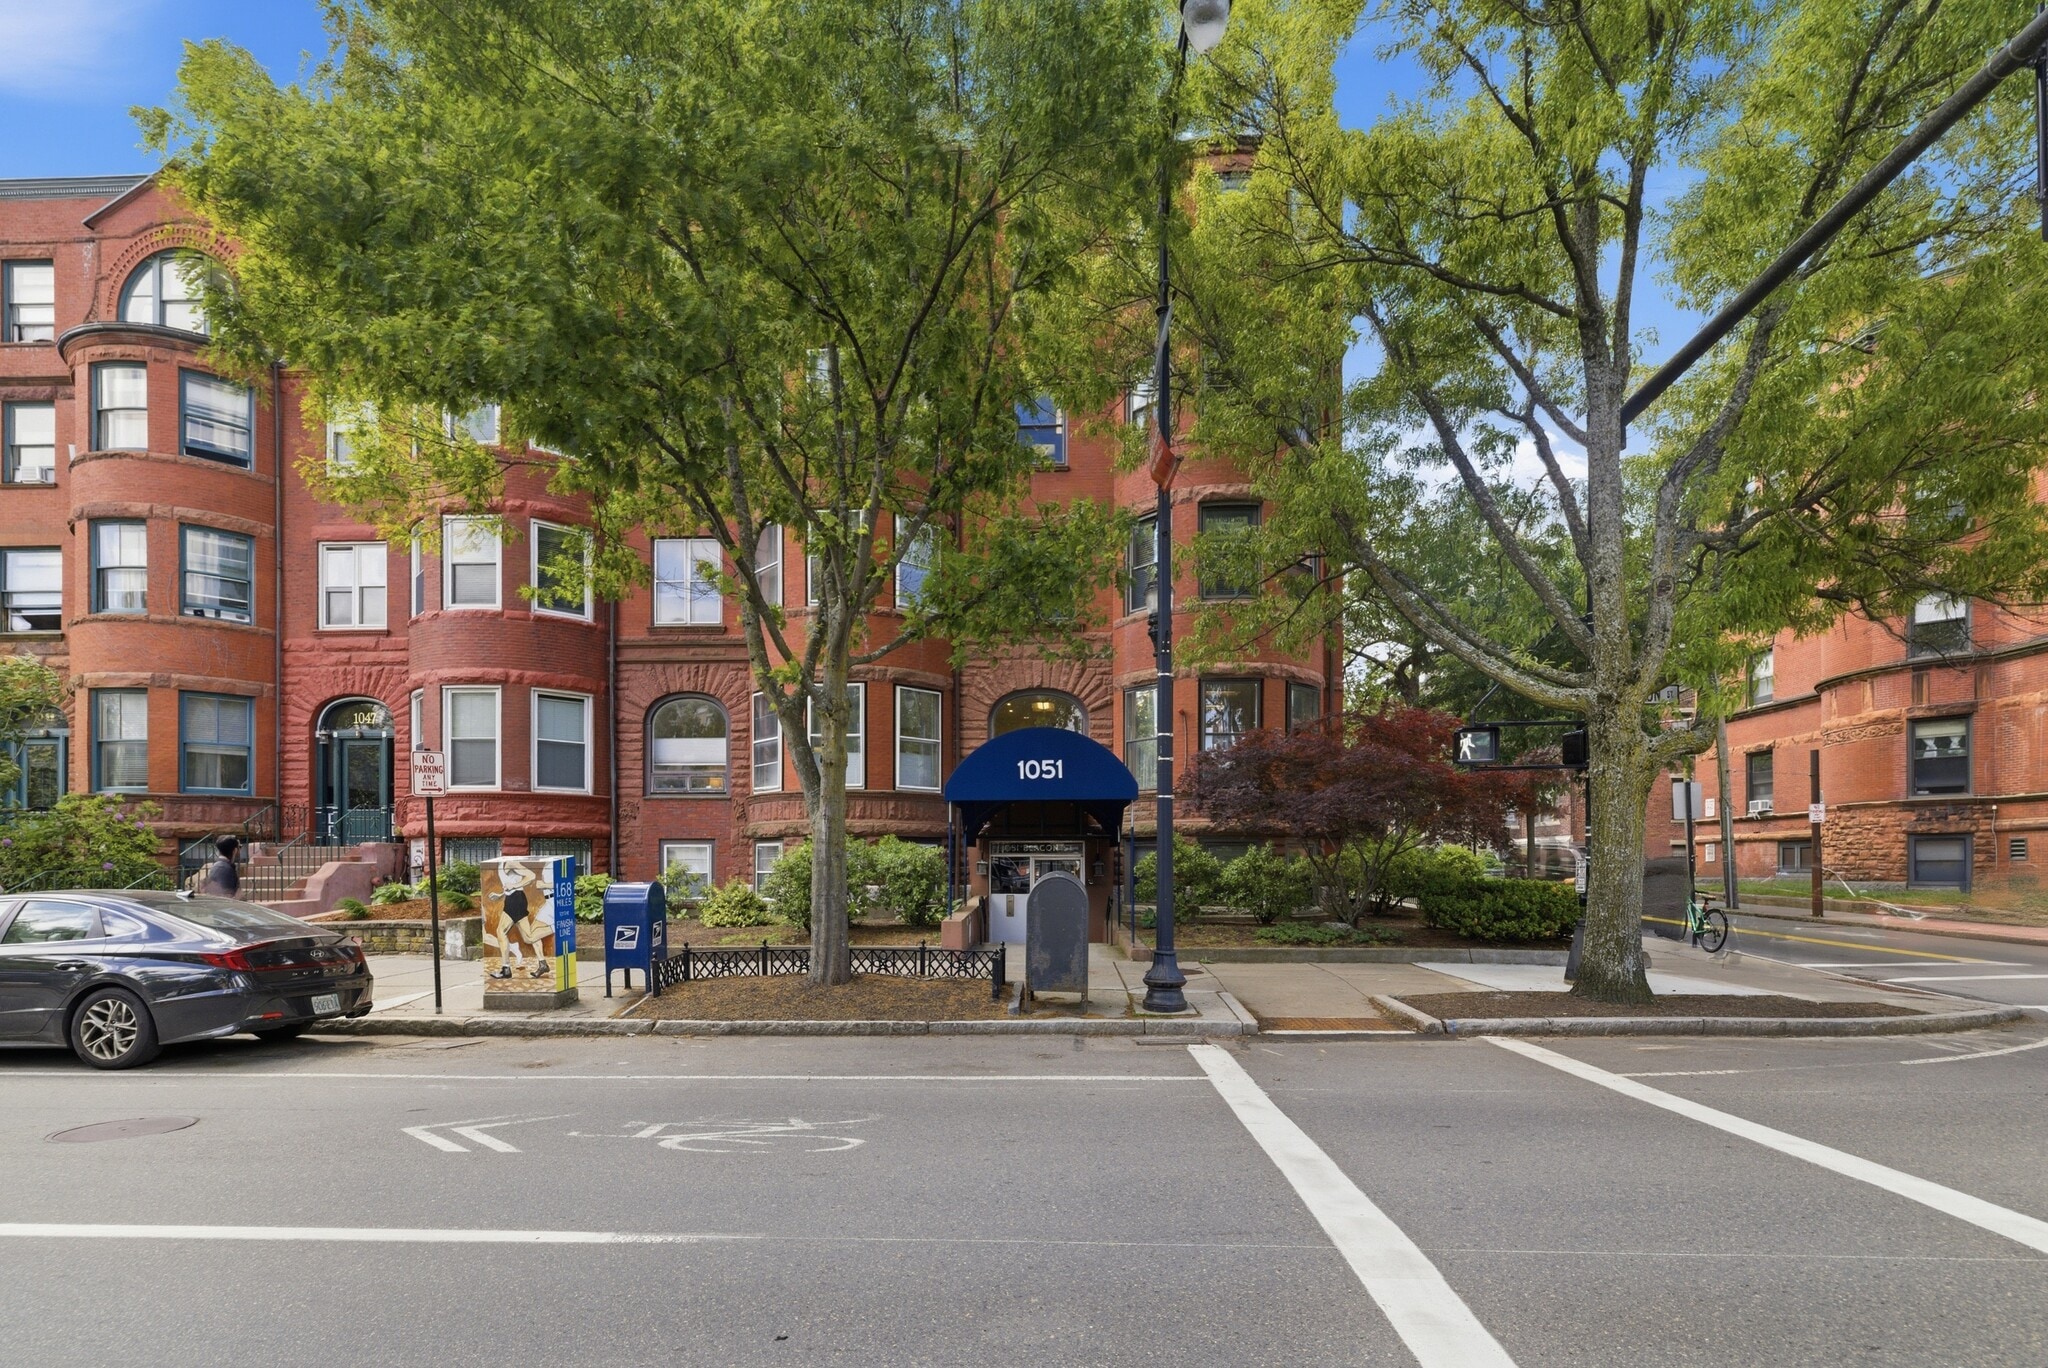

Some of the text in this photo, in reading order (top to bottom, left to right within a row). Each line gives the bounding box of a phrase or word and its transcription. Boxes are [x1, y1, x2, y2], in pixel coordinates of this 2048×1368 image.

[353, 712, 376, 725] 1047
[422, 755, 435, 764] NO
[415, 764, 444, 775] PARKING
[1017, 759, 1063, 780] 1051
[1023, 844, 1059, 852] BEACON
[556, 881, 572, 898] 1.68
[556, 897, 572, 908] MILES
[556, 919, 574, 929] FINISH
[559, 927, 571, 938] LINE
